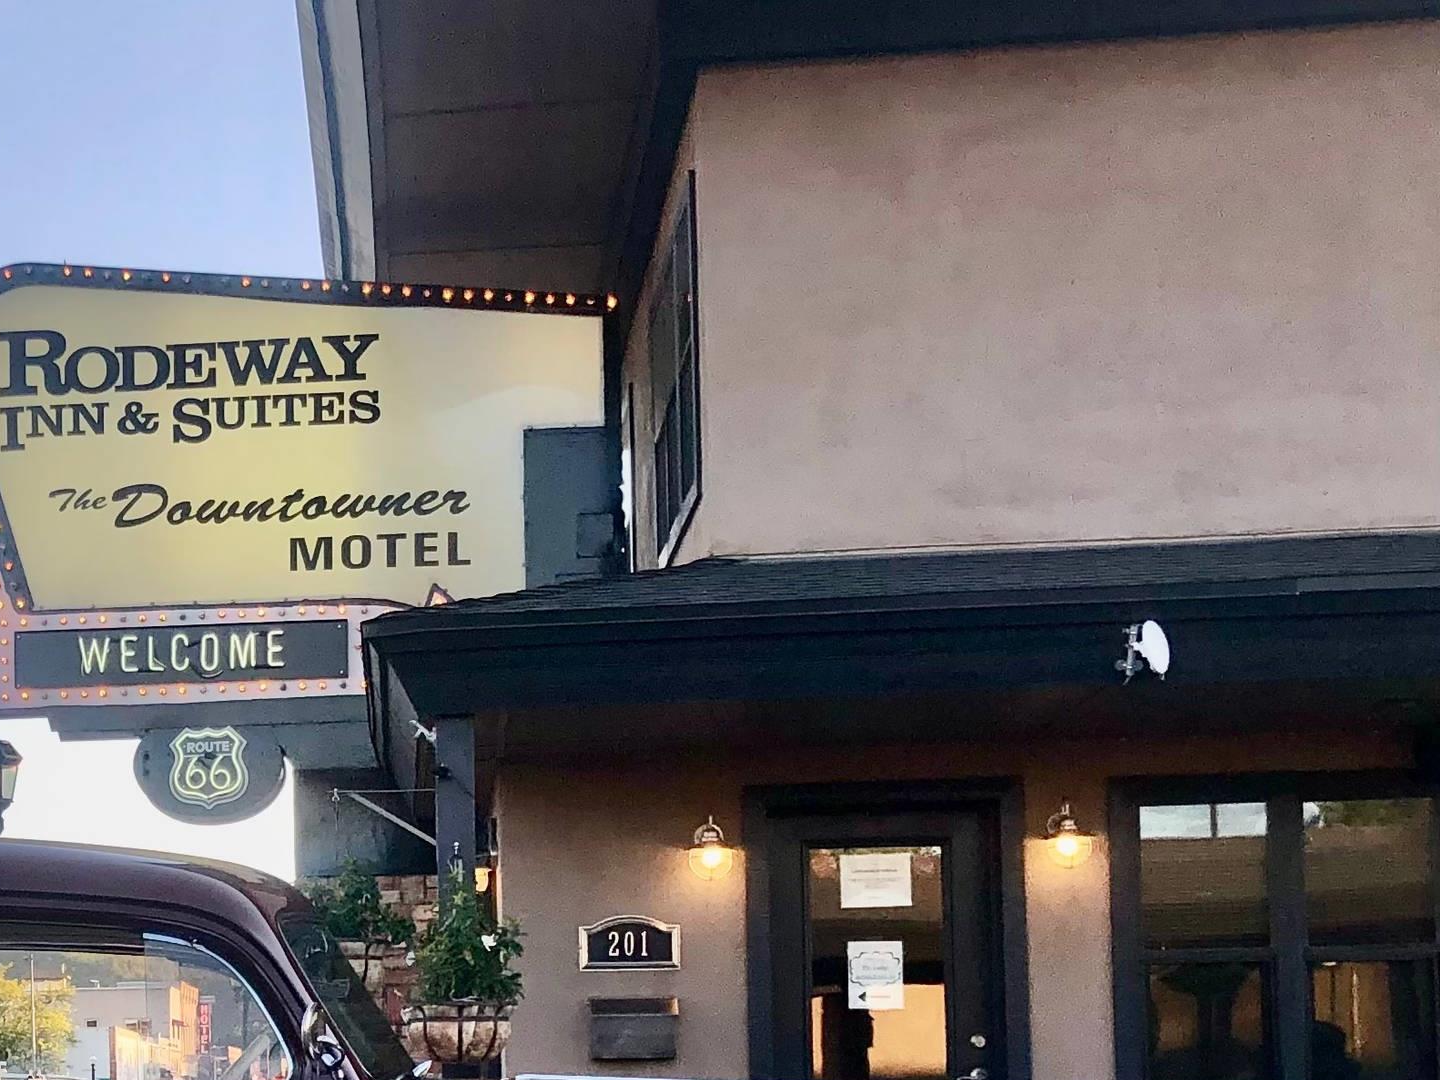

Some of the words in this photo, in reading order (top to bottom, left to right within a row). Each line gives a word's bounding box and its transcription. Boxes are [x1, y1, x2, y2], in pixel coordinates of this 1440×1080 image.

[0, 402, 109, 452] INN
[117, 402, 159, 434] &
[172, 390, 382, 444] SUITES
[48, 488, 107, 512] The
[112, 484, 470, 529] Downtowner
[289, 531, 471, 572] MOTEL
[78, 630, 285, 675] WELCOME
[186, 740, 231, 754] ROUTE
[184, 755, 232, 790] 66
[608, 931, 649, 957] 201
